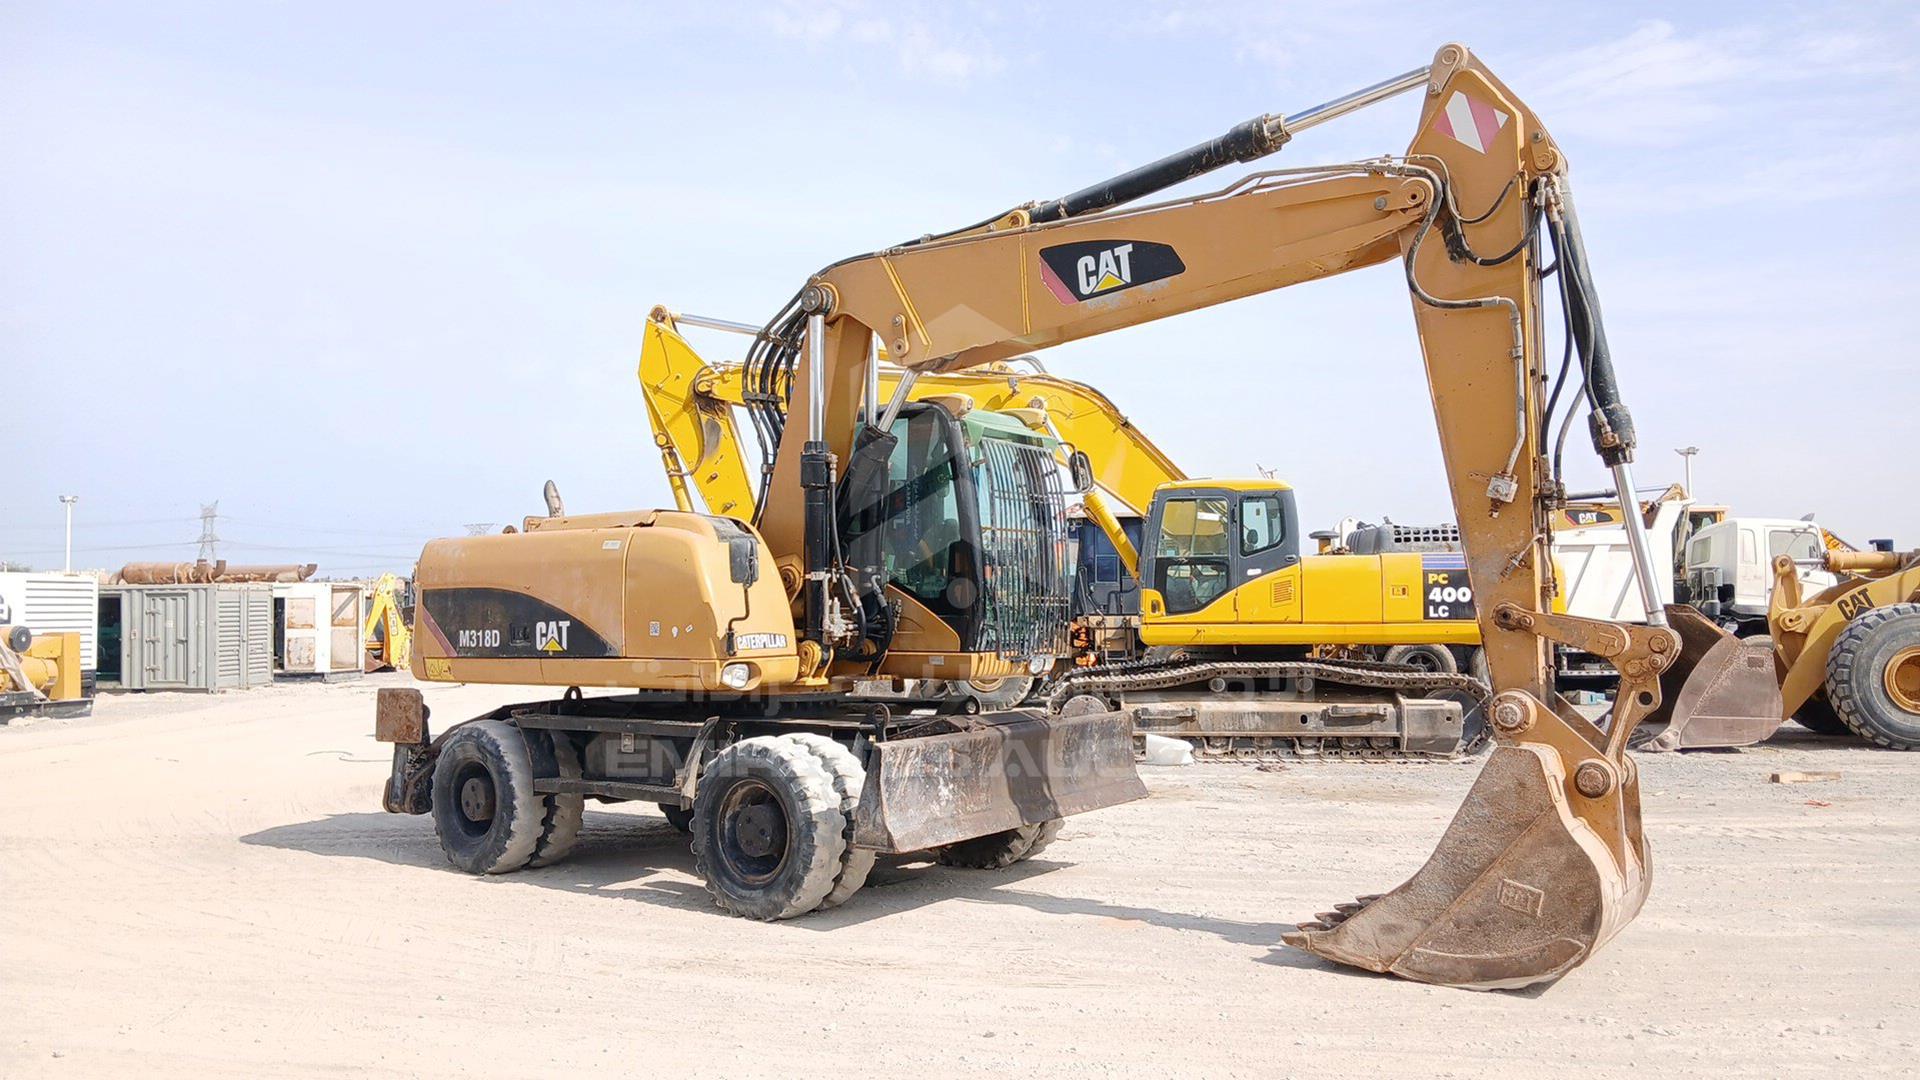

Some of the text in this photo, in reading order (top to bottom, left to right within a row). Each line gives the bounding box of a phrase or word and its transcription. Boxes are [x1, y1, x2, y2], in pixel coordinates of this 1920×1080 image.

[1077, 243, 1133, 295] CAT
[1579, 512, 1597, 524] CAT
[1428, 573, 1449, 585] PC
[1428, 587, 1472, 603] 400
[1429, 605, 1449, 617] LC
[1837, 588, 1875, 621] CAT
[459, 629, 500, 648] M318D
[536, 621, 570, 651] CAT
[736, 634, 787, 650] CATERPILLAR
